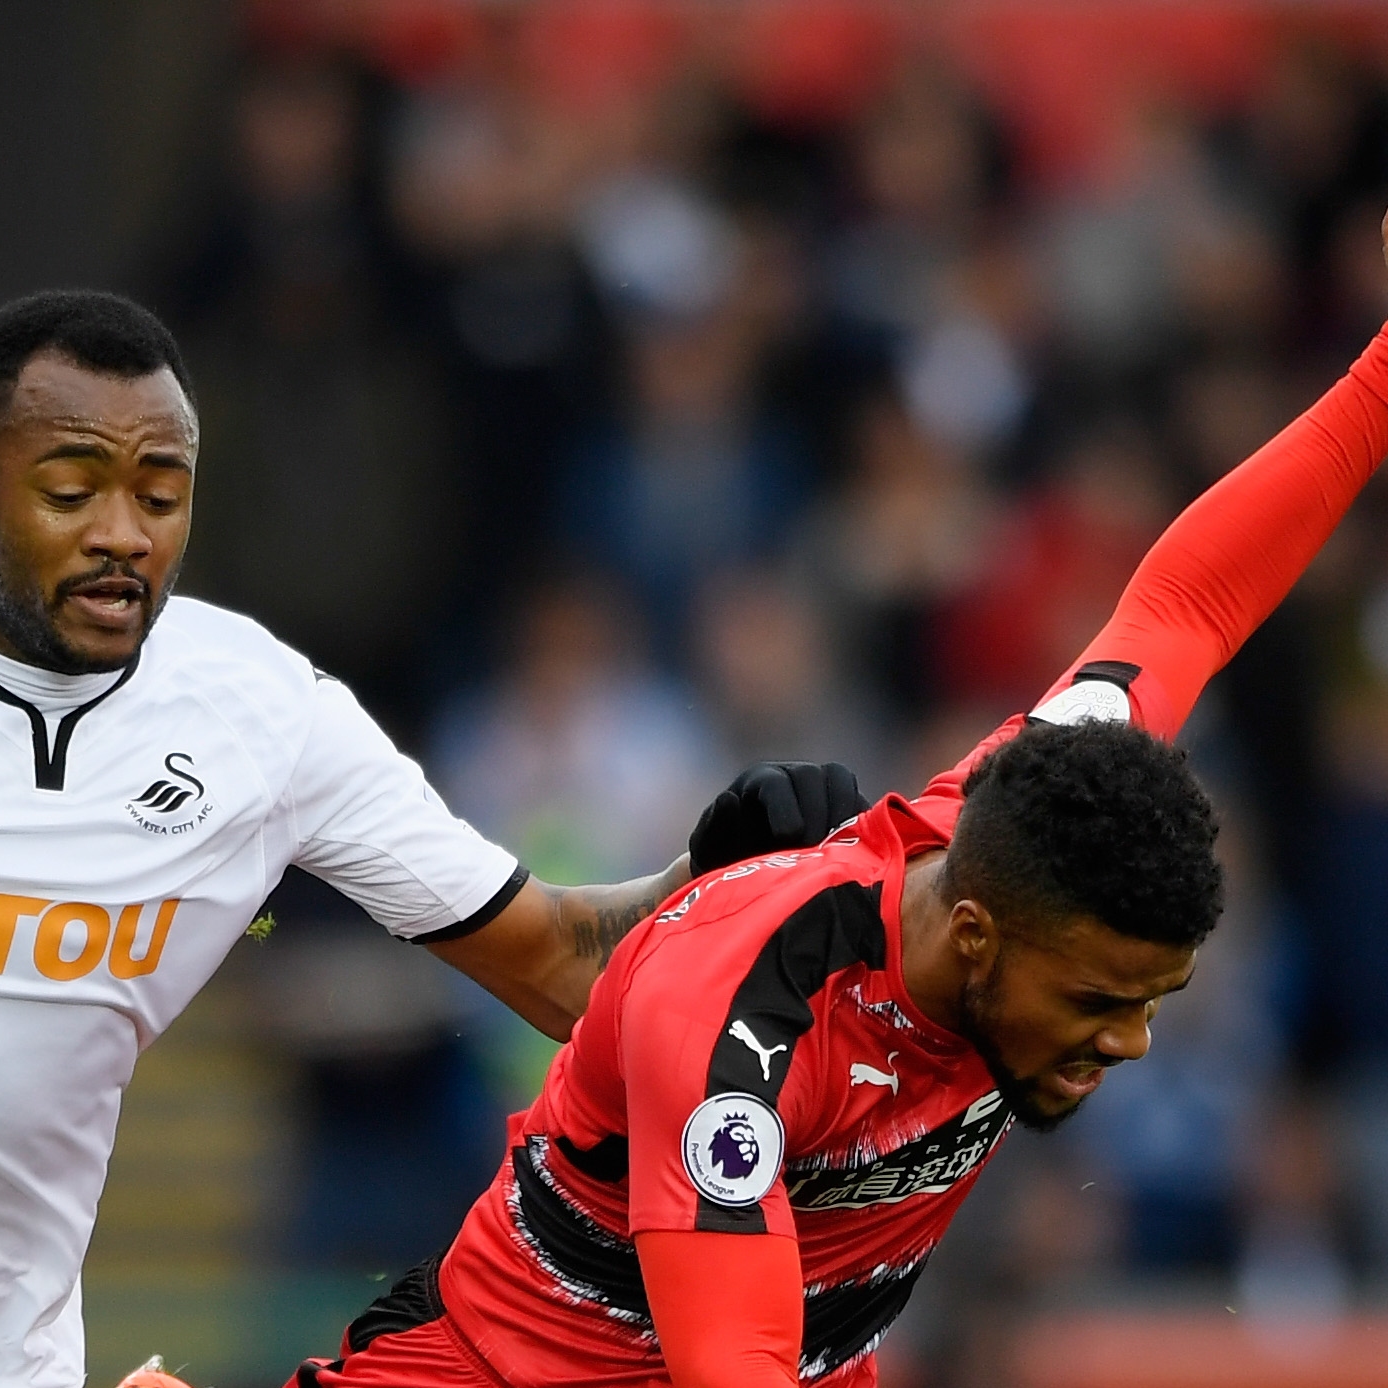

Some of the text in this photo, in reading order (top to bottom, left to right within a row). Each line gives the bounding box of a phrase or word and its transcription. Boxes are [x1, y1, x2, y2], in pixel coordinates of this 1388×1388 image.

[124, 803, 214, 835] SWANSEA CITY AFC
[703, 1174, 736, 1196] League
